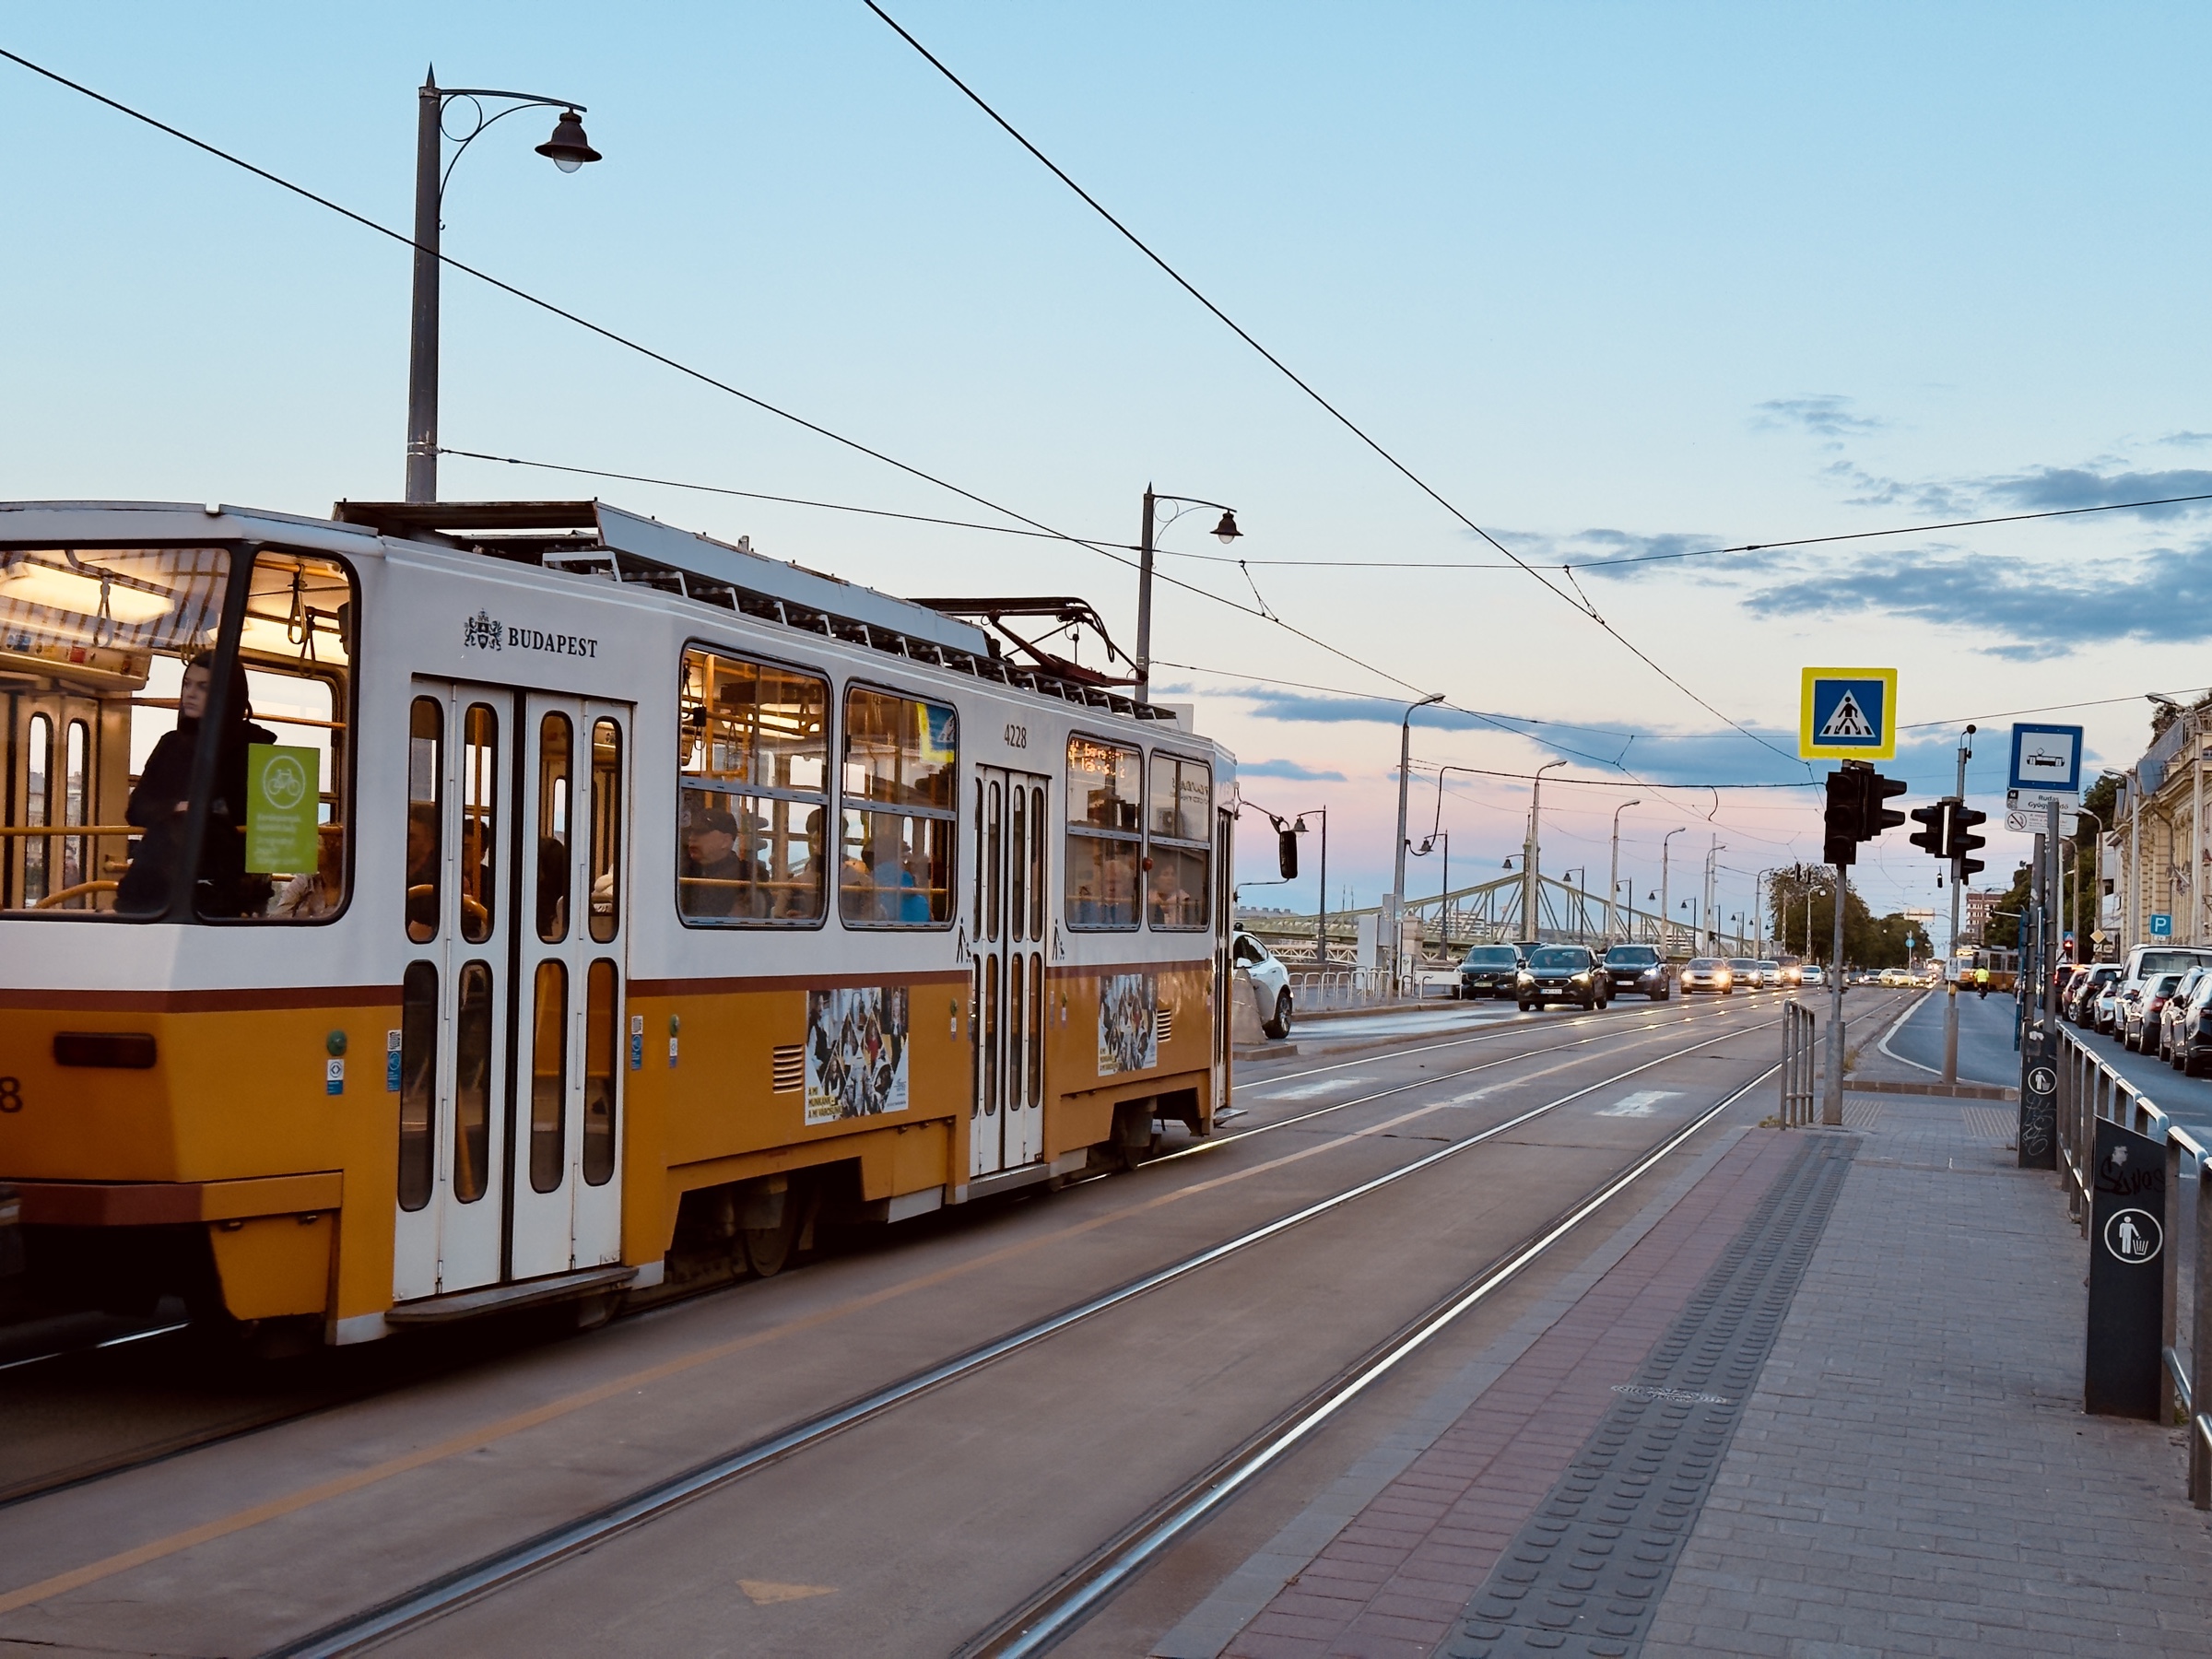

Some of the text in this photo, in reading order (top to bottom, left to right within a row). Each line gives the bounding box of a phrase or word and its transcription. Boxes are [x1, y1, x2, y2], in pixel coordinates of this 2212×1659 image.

[508, 627, 598, 658] BUDAPEST
[1004, 724, 1027, 749] 4228
[2028, 802, 2068, 810] Gyógydő
[2155, 917, 2167, 933] P
